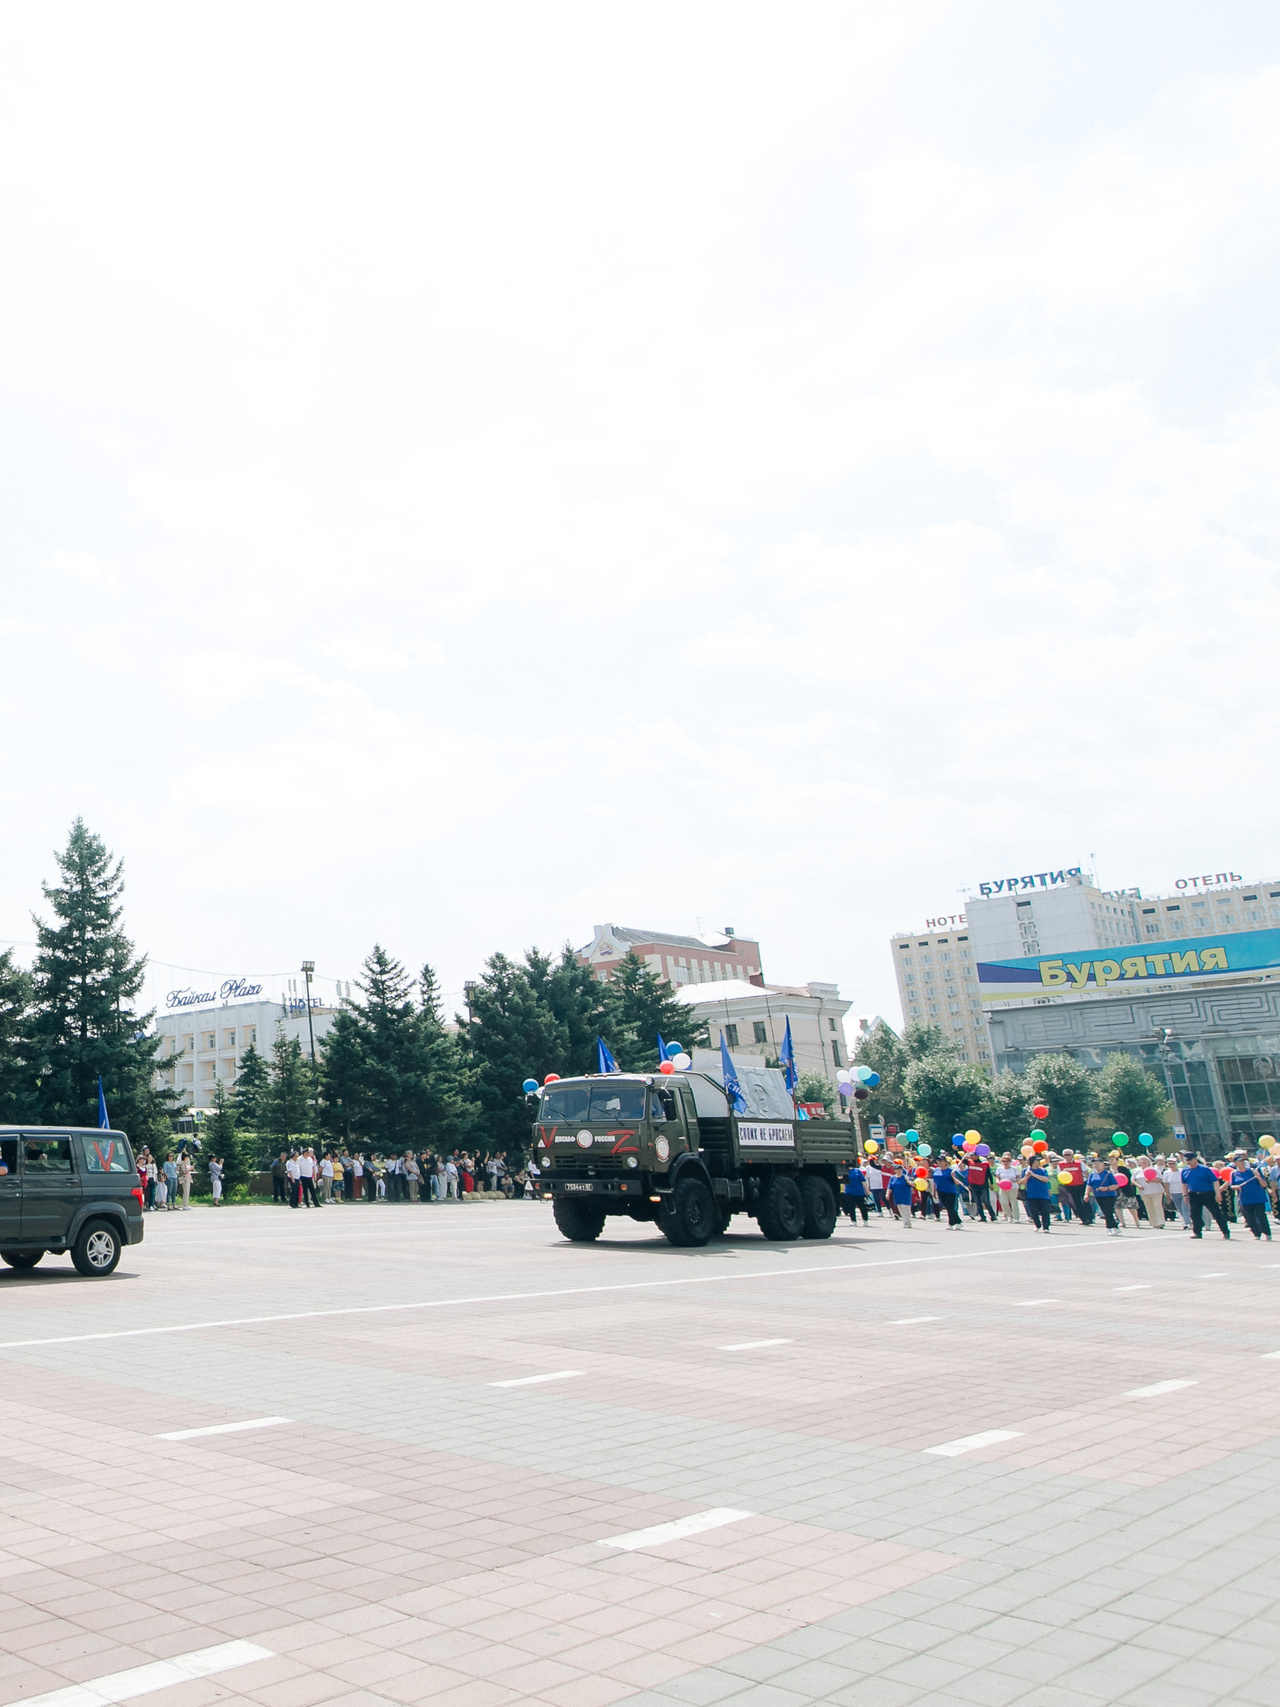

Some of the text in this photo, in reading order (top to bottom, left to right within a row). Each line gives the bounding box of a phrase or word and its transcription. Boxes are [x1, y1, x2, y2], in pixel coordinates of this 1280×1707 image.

[979, 867, 1081, 896] БУРЯТИЯ
[1175, 872, 1243, 890] ОТЕЛЬ
[926, 913, 967, 928] HOTE
[1038, 946, 1229, 989] Бурятия
[166, 978, 263, 1008] Байкал Plaza
[92, 1141, 115, 1172] V
